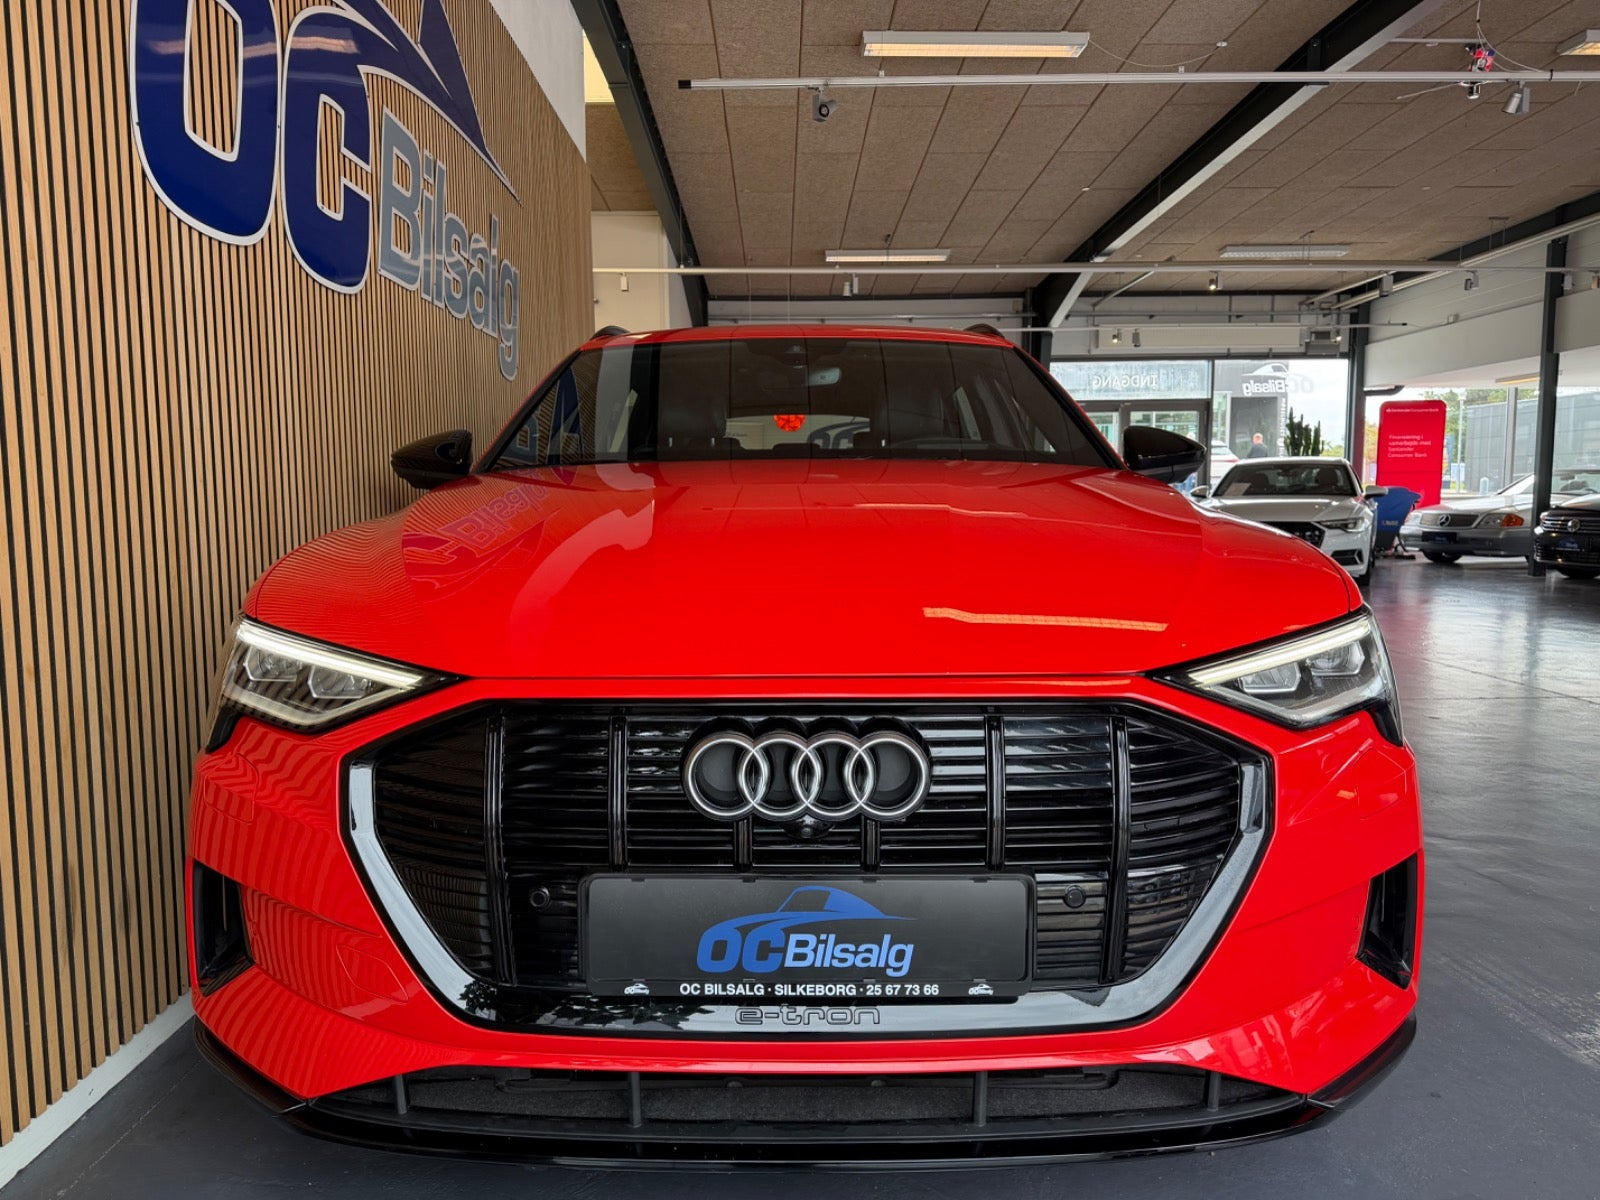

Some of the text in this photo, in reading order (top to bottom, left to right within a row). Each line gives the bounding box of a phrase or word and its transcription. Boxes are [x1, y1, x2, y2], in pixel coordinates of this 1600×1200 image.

[378, 107, 519, 381] Bilsalg
[784, 933, 914, 977] Bilsalg
[679, 982, 939, 997] OC BILSALG SILKEBORG 25 67 73 66
[734, 1003, 880, 1026] e-tron
